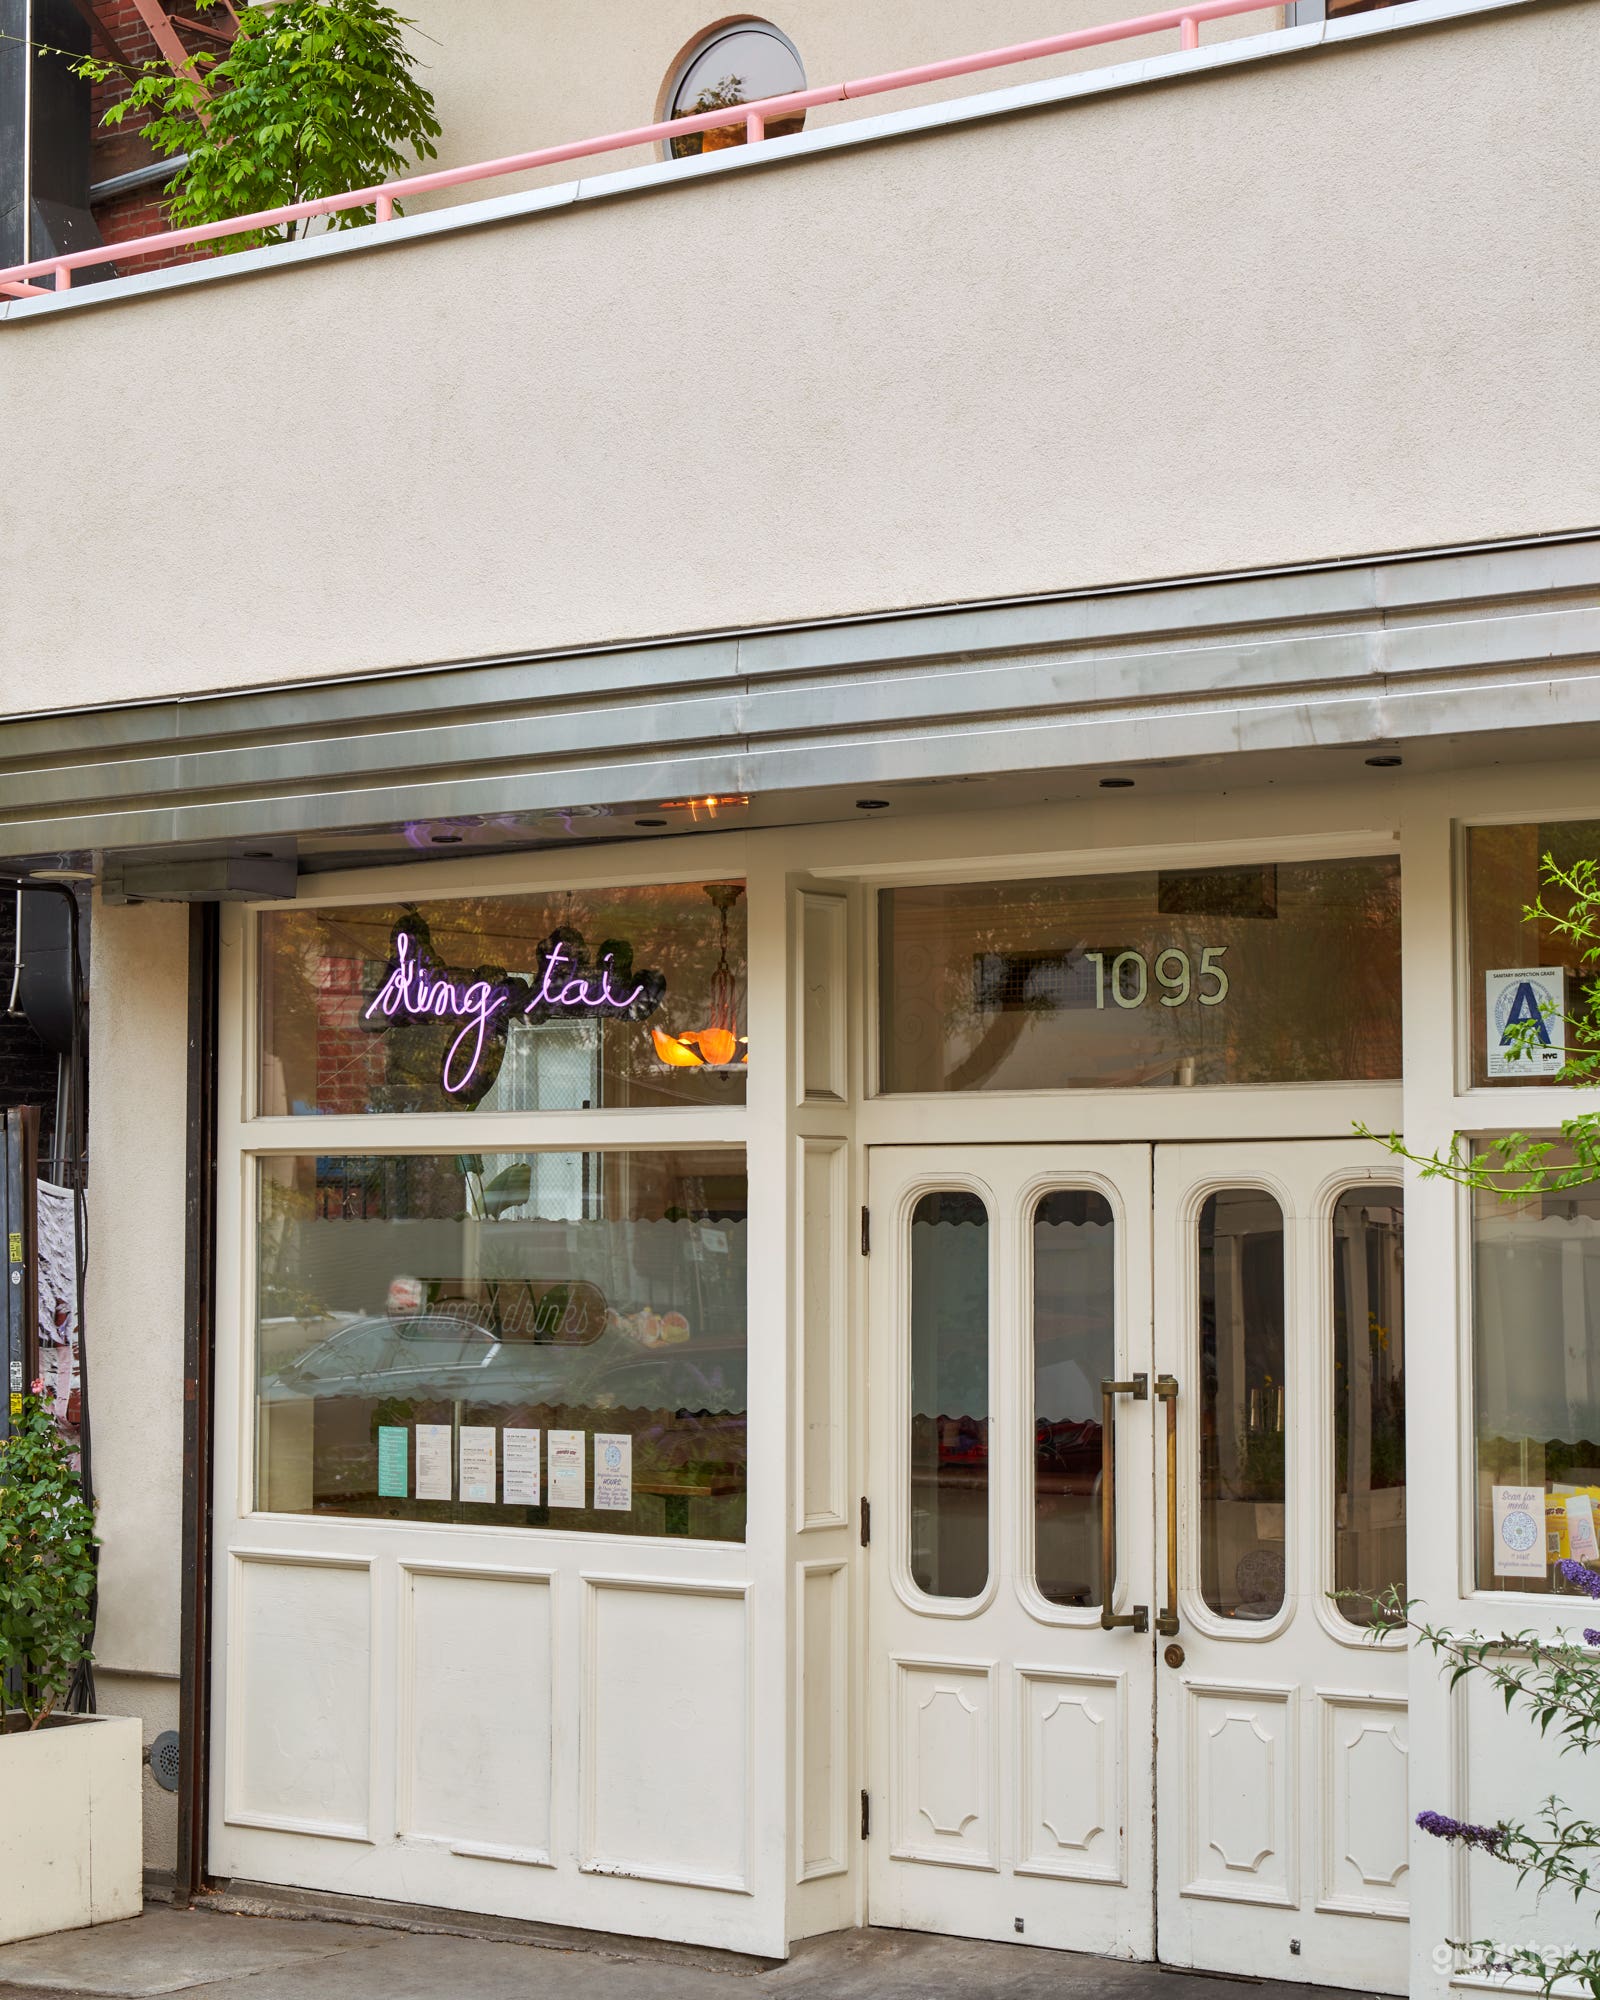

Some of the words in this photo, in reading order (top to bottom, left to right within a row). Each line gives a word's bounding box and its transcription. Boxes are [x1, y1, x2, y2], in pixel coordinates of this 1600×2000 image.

[524, 941, 644, 1014] tai
[1084, 946, 1230, 1009] 1095
[1499, 982, 1551, 1046] A
[502, 1286, 589, 1335] drinks
[1501, 1490, 1521, 1501] Scan
[1522, 1490, 1536, 1504] for
[1506, 1502, 1529, 1510] menu
